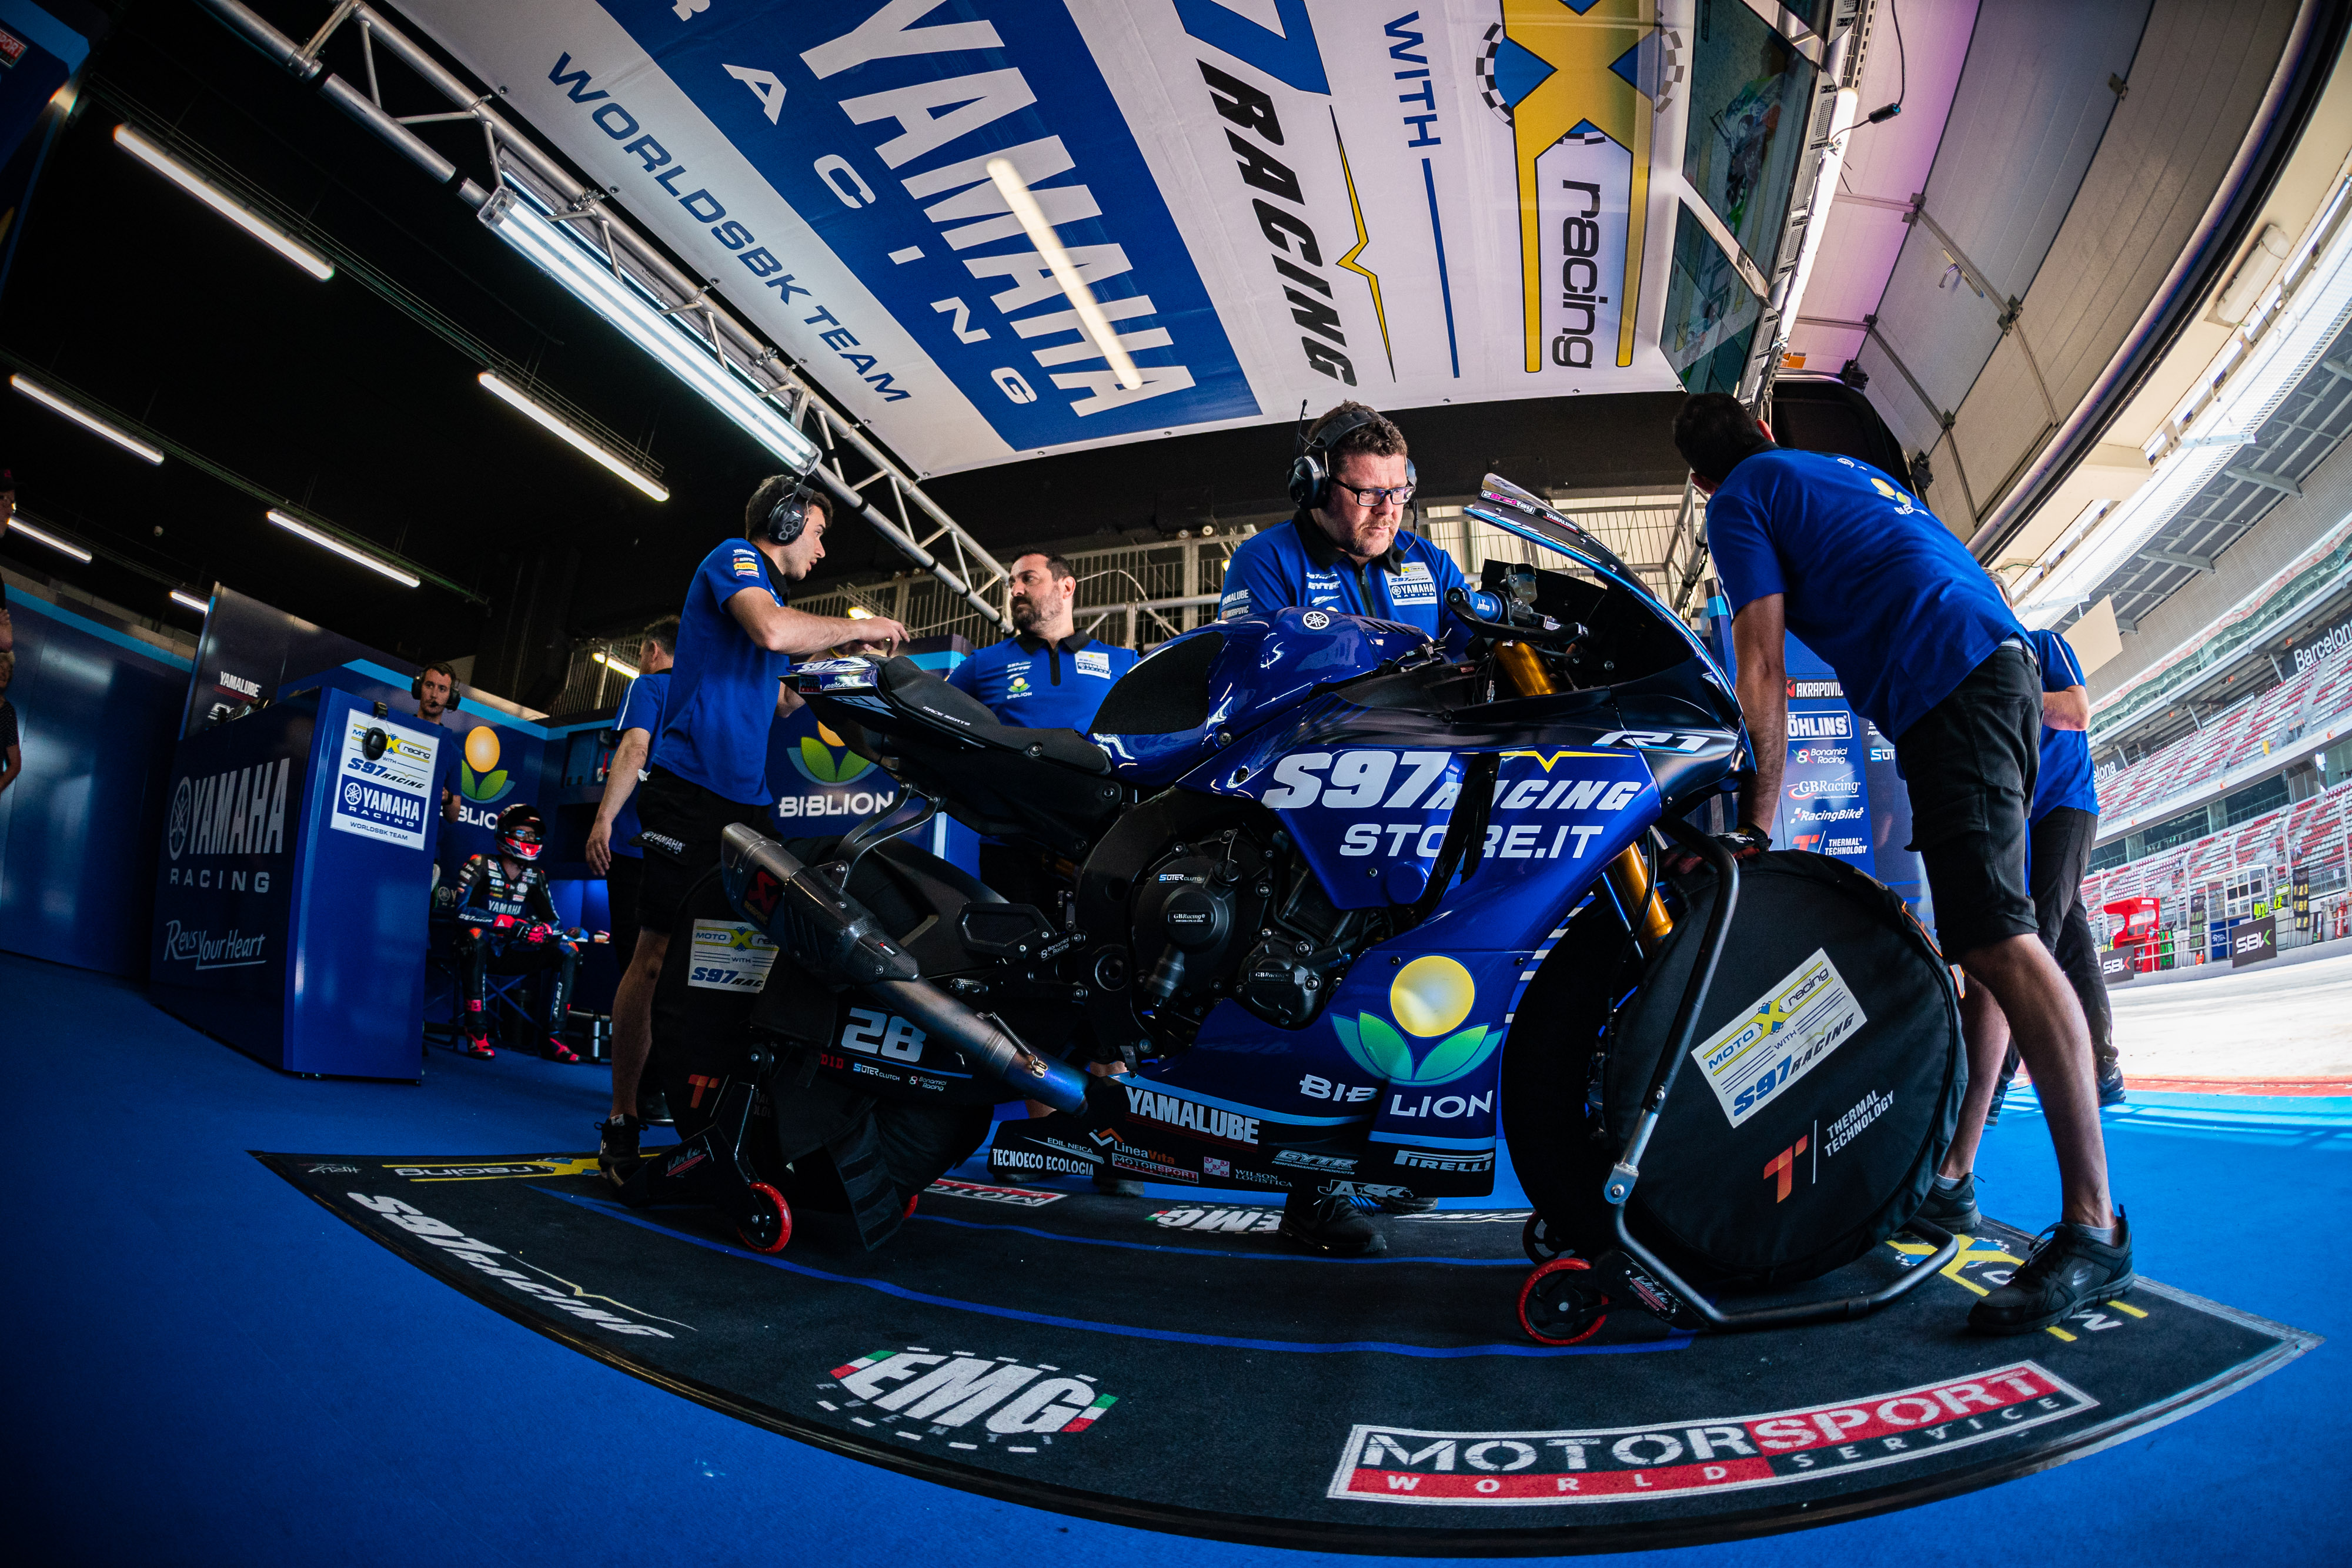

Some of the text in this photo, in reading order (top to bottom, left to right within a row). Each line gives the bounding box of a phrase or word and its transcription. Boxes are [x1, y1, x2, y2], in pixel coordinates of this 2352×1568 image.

[1384, 11, 1441, 148] WITH
[800, 0, 1196, 417] YAMAHA
[548, 51, 912, 403] WORLDSBK TEAM
[1195, 58, 1357, 387] RACING
[1552, 179, 1608, 369] racing
[1546, 512, 1578, 531] YAMALUBE
[1401, 583, 1435, 594] YAMAHA
[220, 671, 260, 698] YAMALUBE
[1788, 714, 1847, 737] ÖHLINS
[403, 745, 431, 759] racing
[1810, 747, 1848, 757] Bonamici
[1818, 755, 1845, 764] Racing
[1870, 748, 1895, 761] SUT
[348, 757, 425, 789] S97 RACING
[1262, 751, 1642, 811] S97 RCING
[2093, 761, 2117, 783] elona
[1799, 779, 1858, 793] GBRacing
[189, 758, 290, 854] YAMAHA
[363, 787, 420, 821] YAMAHA
[779, 791, 894, 817] BIBLION
[349, 805, 415, 828] RACING
[1800, 808, 1863, 822] RacingBike
[350, 821, 408, 841] WORLDSBK TEAM
[652, 833, 683, 852] YAMAHA
[1825, 845, 1867, 856] TECHNOLOGY
[1829, 838, 1859, 847] THERMAL
[170, 868, 270, 893] RACING
[489, 900, 522, 915] YAMAHA
[696, 932, 727, 941] MOTO
[2236, 929, 2271, 954] SBK
[1053, 943, 1069, 954] Racing
[691, 967, 739, 984] S97
[2103, 956, 2131, 975] SBK
[1709, 1029, 1755, 1069] MOTO
[1788, 967, 1829, 1007] racing
[1774, 1030, 1797, 1050] WITH
[820, 1054, 844, 1069] DID
[853, 1062, 900, 1081] SUTER CLUTCH
[1733, 1012, 1855, 1116] S97 RACING
[918, 1076, 947, 1085] Bonamici
[922, 1083, 944, 1091] Racing
[1125, 1086, 1260, 1145] YAMALUBE
[1824, 1090, 1894, 1157] TECHNOLOGY
[1827, 1089, 1880, 1139] THERMAL
[1047, 1137, 1093, 1154] EDIL NEICA
[993, 1148, 1094, 1176] TECNOECO ECOLOGIA
[1114, 1155, 1196, 1179] MOTORSPORT
[1272, 1161, 1319, 1171] PERFORMANCE
[1275, 1150, 1356, 1169] GYTR
[1394, 1149, 1494, 1172] PIRELLI
[395, 1164, 534, 1177] racing
[1235, 1169, 1278, 1180] WILSON
[1235, 1175, 1293, 1188] LOGISTICA
[839, 1352, 1095, 1434] EMG
[1361, 1367, 2042, 1473] MOTORSPORT
[1387, 1396, 2061, 1493] WORLD SERVICE
